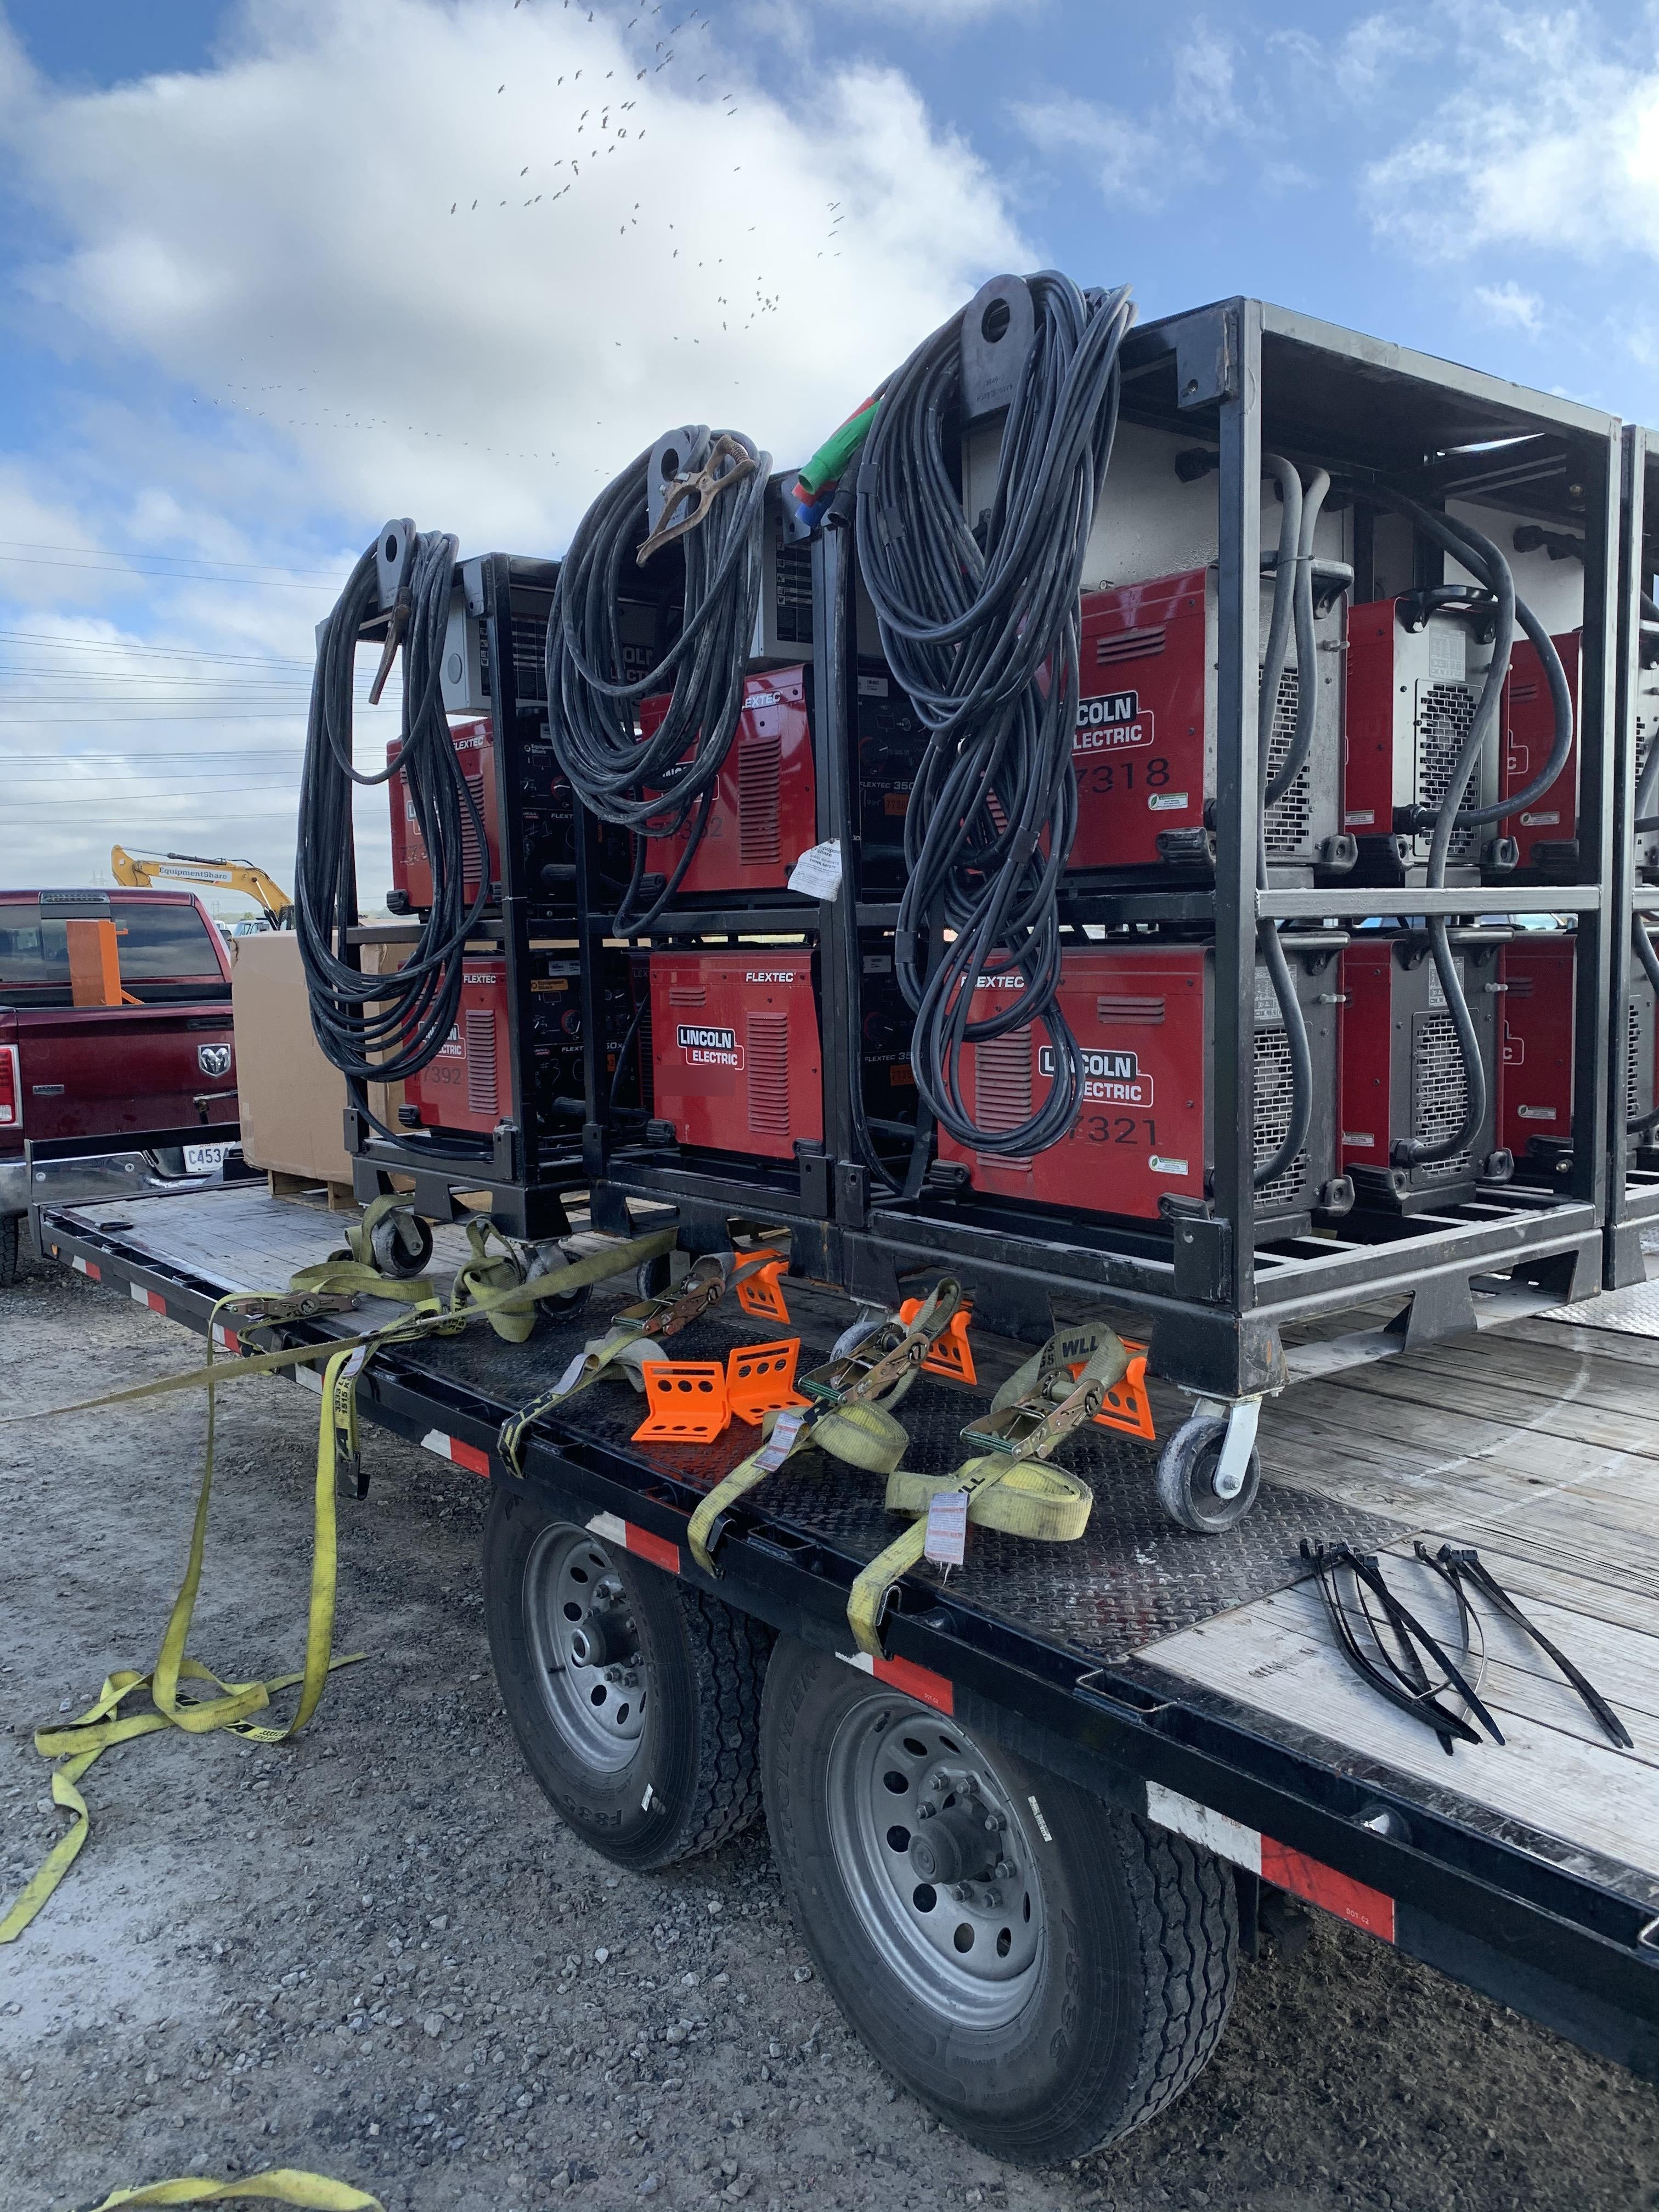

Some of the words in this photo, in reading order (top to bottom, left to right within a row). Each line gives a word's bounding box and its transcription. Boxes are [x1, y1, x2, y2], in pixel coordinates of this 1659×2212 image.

[742, 692, 782, 710] EXTEC
[1076, 697, 1131, 726] COLN
[1073, 725, 1142, 750] LECTRIC
[160, 867, 228, 879] EquipmentShare
[463, 975, 496, 984] FLEXTEC
[746, 972, 794, 983] FLEXTEC
[680, 1029, 731, 1048] LINCOLN
[692, 1050, 738, 1065] ELECTRIC
[1084, 1081, 1142, 1101] ECTRIC
[1062, 1335, 1098, 1358] WLL
